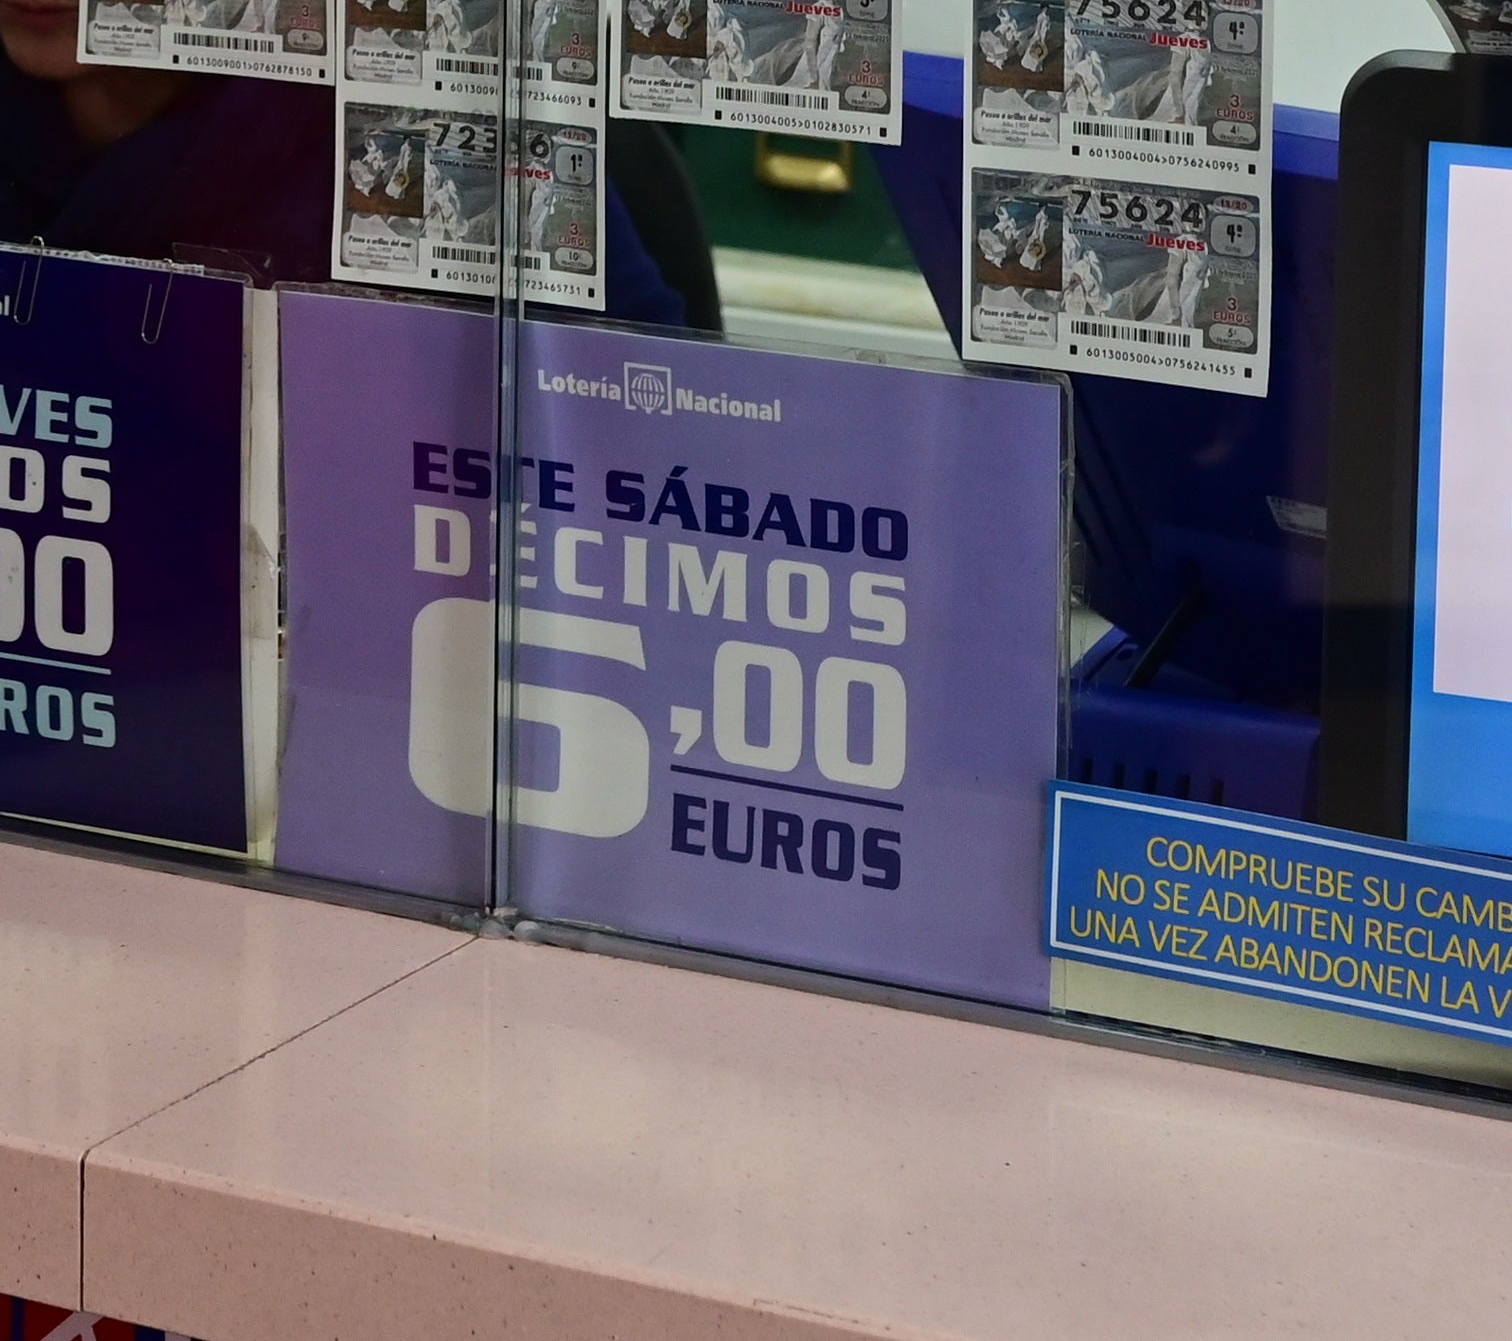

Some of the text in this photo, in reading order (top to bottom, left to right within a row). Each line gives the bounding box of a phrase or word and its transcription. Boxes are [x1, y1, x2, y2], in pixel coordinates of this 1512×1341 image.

[604, 465, 910, 561] SÁBADO
[408, 596, 908, 838] 6,00
[671, 793, 902, 891] EUROS
[1146, 835, 1356, 904] COMPRUEBE
[1363, 875, 1408, 914] SU
[1096, 867, 1146, 906] NO
[1154, 878, 1192, 915] SE
[1197, 887, 1355, 945] ADMITEN
[1070, 904, 1142, 948] UNA
[1148, 919, 1212, 958] VEZ
[1214, 932, 1431, 1005] ABANDONEN
[1440, 980, 1480, 1014] LA
